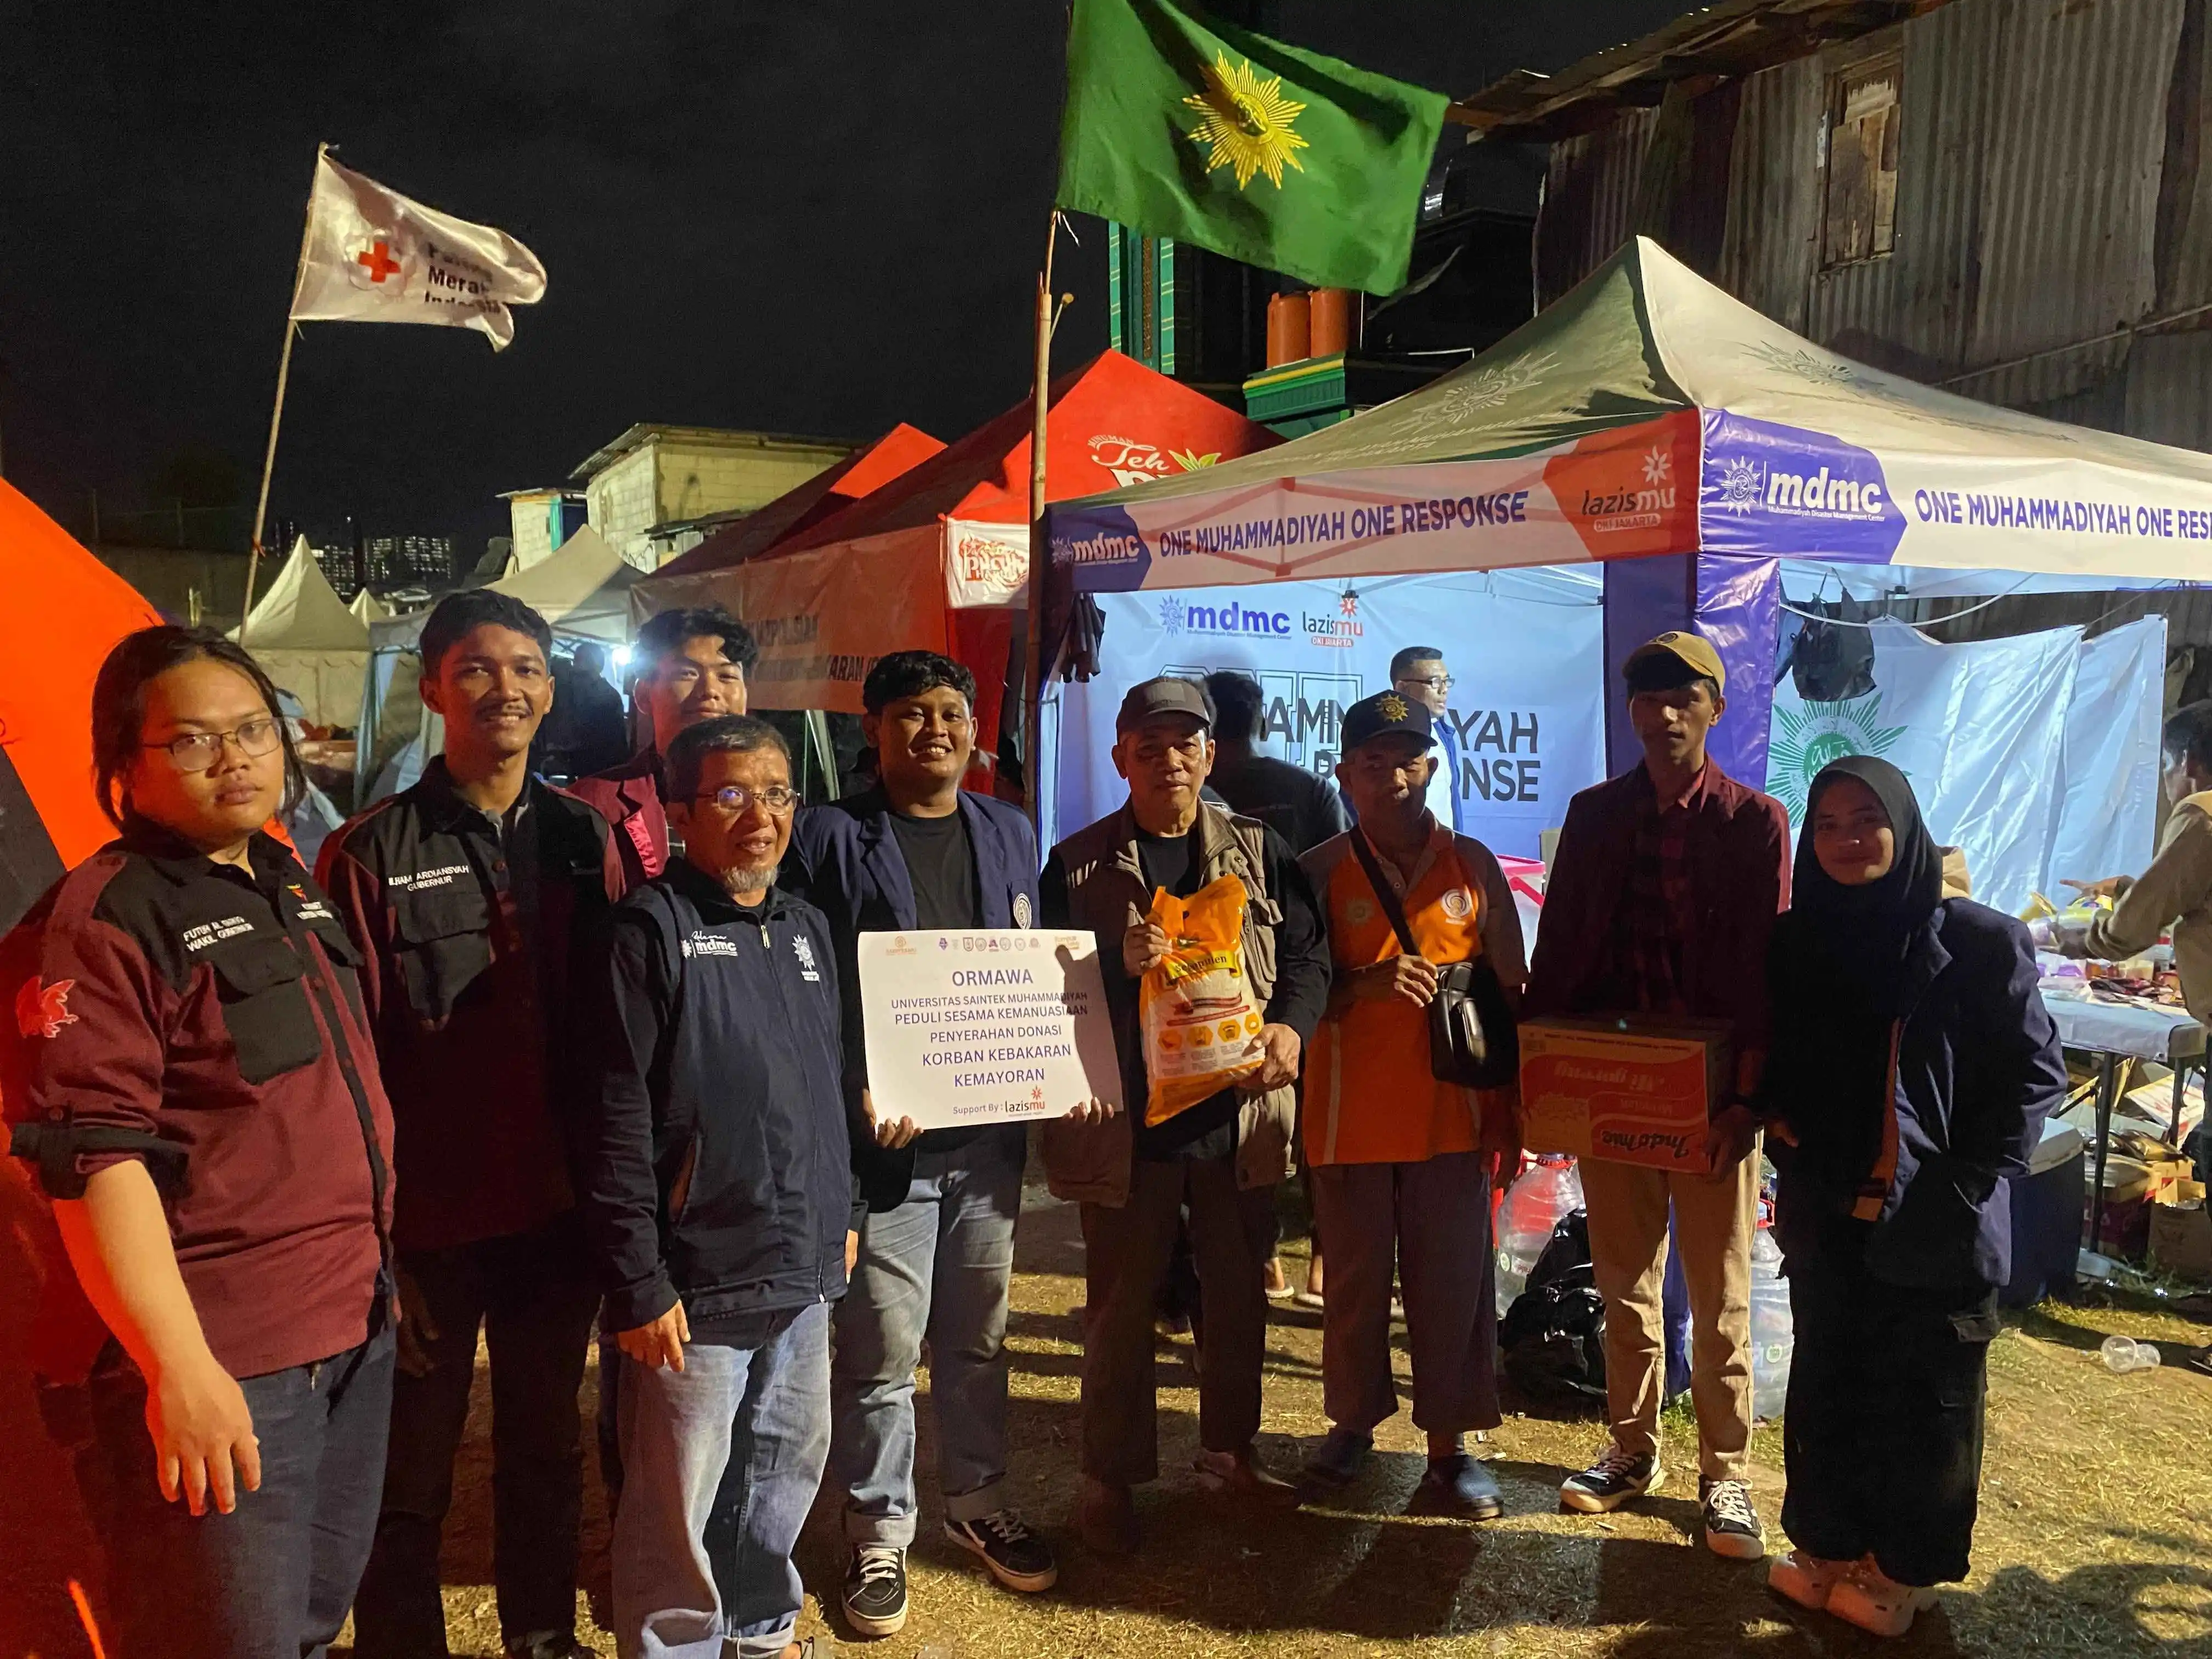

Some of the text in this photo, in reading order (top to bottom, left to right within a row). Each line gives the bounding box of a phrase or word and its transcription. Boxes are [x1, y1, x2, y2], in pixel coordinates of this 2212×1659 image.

[1091, 441, 1170, 471] Teh
[1582, 486, 1675, 516] lazismu
[1767, 467, 1882, 514] mdmc
[1160, 491, 1530, 557] ONE MUHAMMADIYAH ONE RESPONSE
[1915, 489, 1962, 524] ONE
[1966, 494, 2131, 535] MUHAMMADIYAH
[2136, 506, 2173, 537] ONE
[1072, 532, 1139, 562] mdmc
[1187, 602, 1291, 634] mdmc
[1302, 611, 1364, 637] lazismu
[407, 875, 453, 891] GUBERNUR
[695, 939, 737, 951] mdmc
[952, 969, 1034, 986] ORMAWA
[891, 992, 1088, 1009] UNIVERSITAS SAINTEK MUHAMMADIYAH
[895, 1011, 941, 1025] PEDULI
[945, 1009, 995, 1023] SESAMA
[930, 1025, 1062, 1043] PENYERAHAN DONASI
[922, 1043, 1071, 1066] KORBAN KEBAKARAN
[954, 1068, 1045, 1087] KEMAYORAN
[952, 1104, 986, 1115] Support
[1005, 1100, 1046, 1113] lazismu
